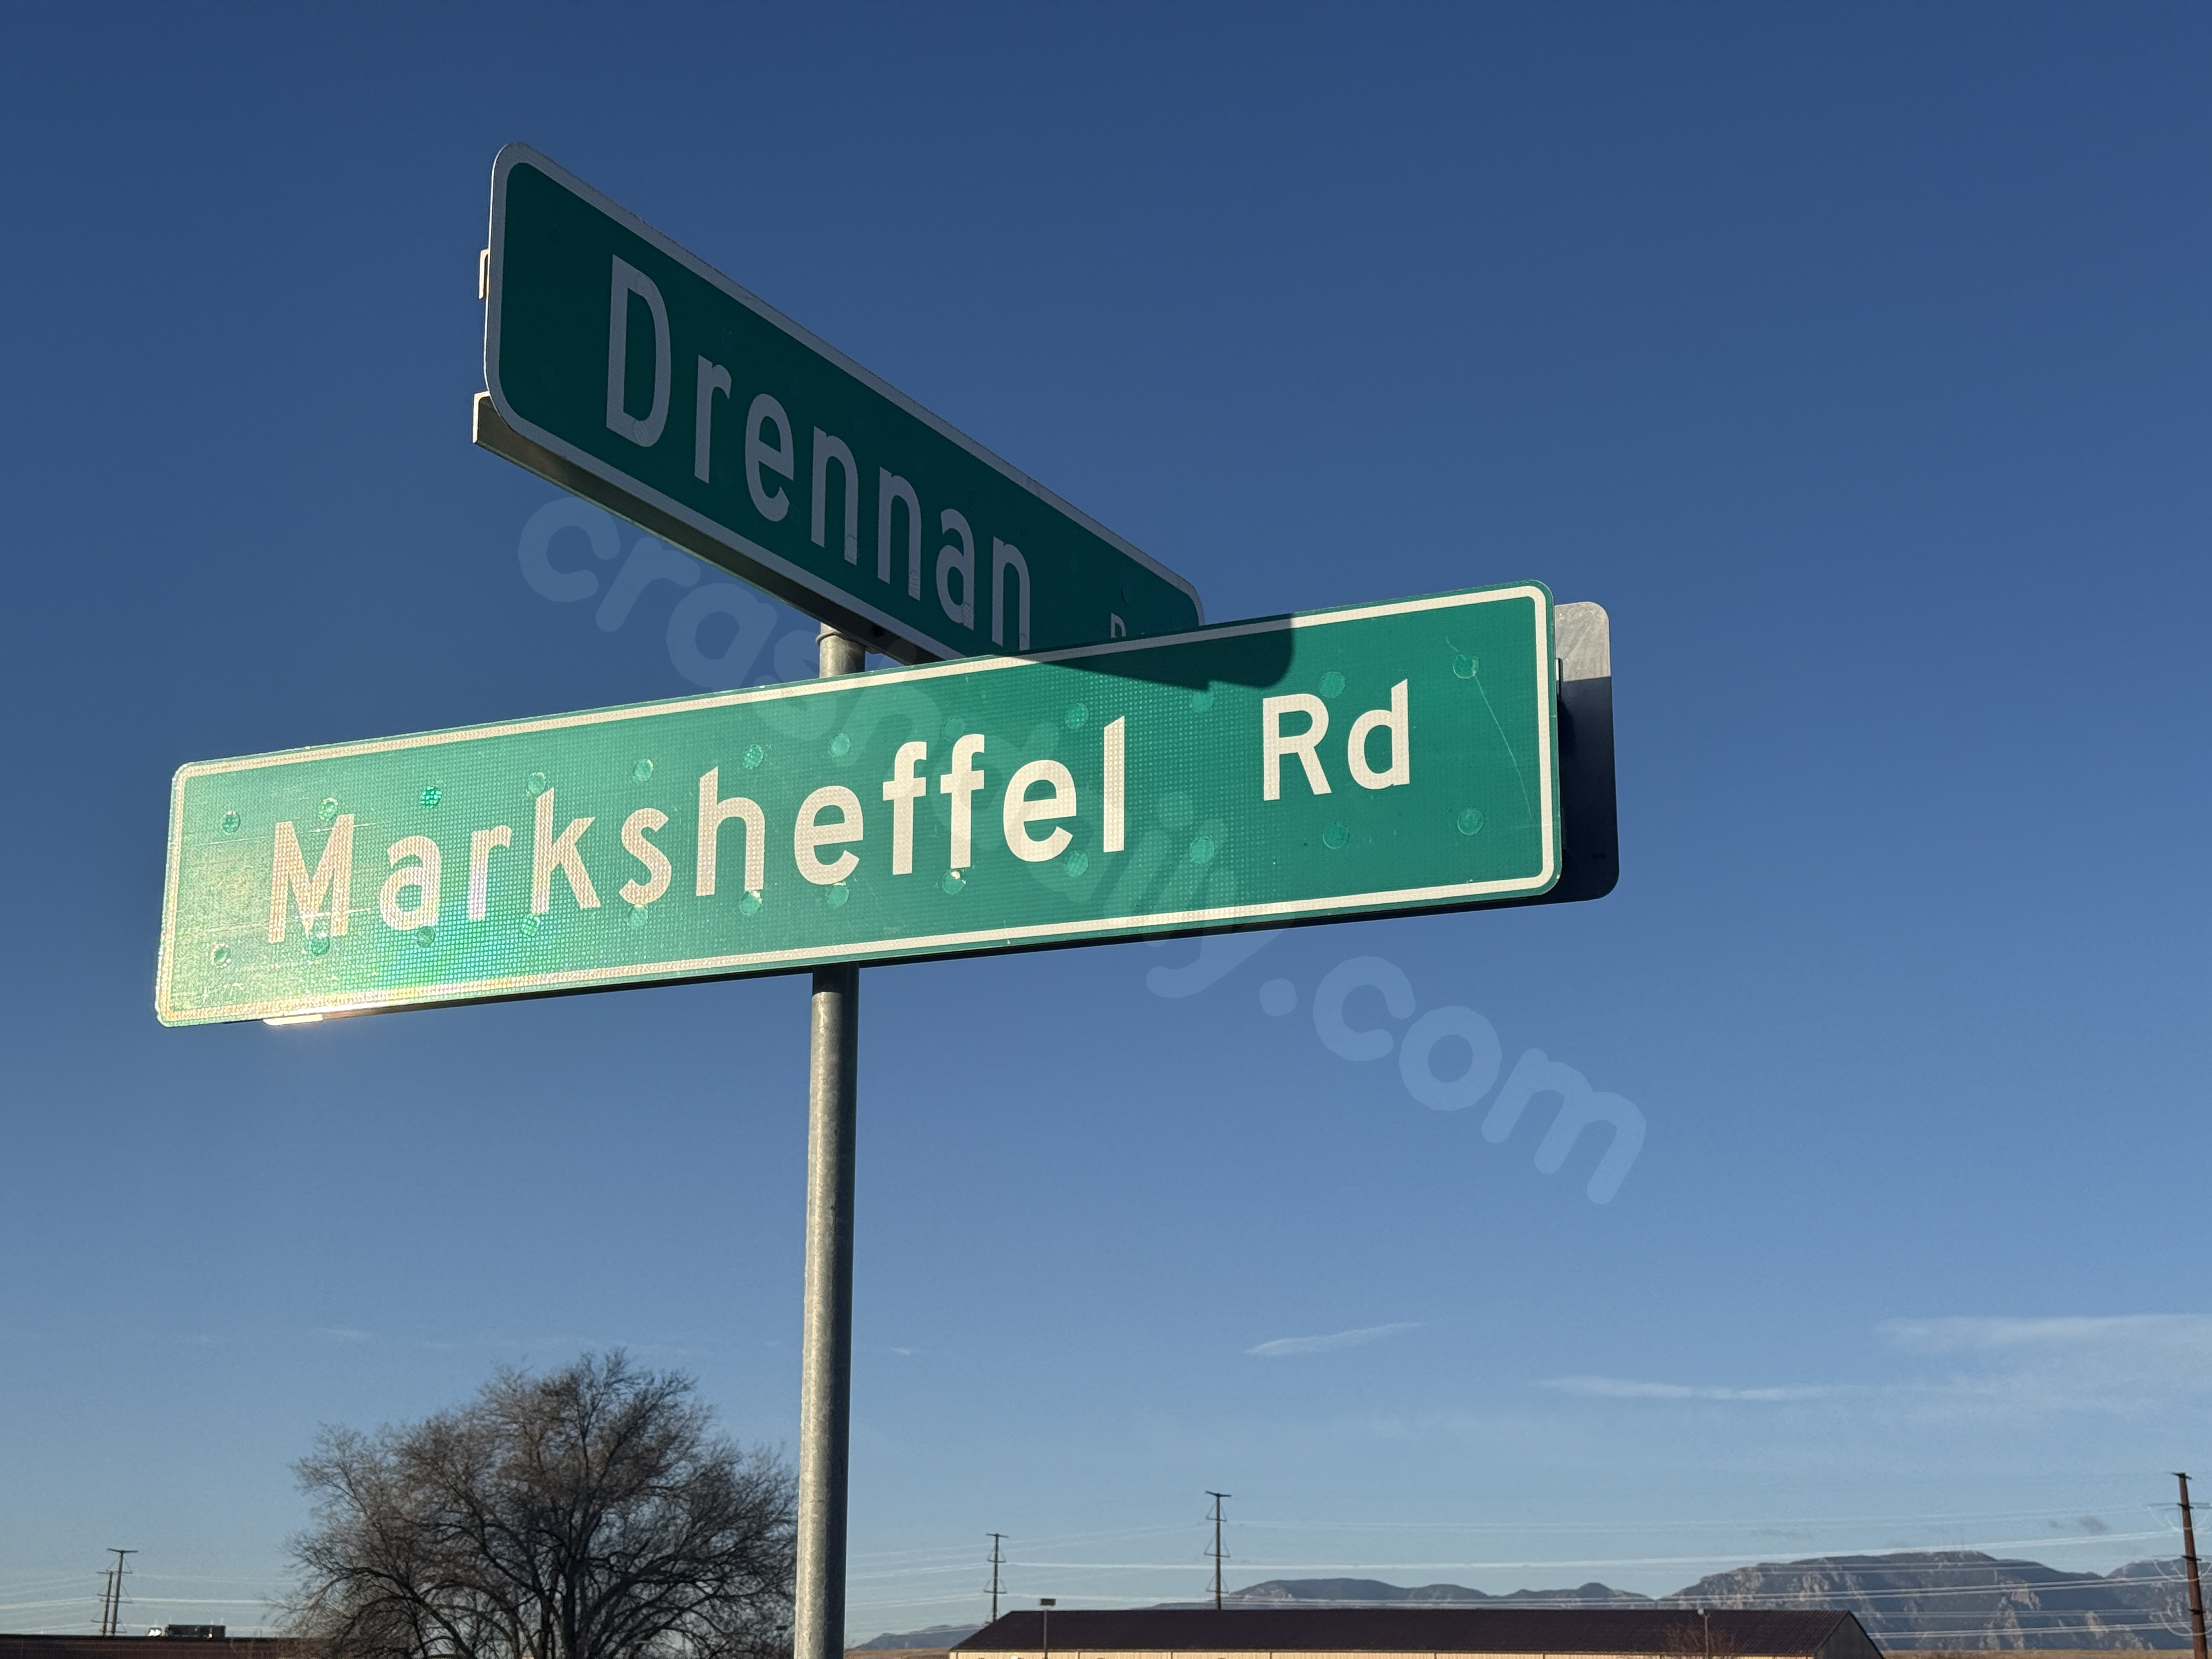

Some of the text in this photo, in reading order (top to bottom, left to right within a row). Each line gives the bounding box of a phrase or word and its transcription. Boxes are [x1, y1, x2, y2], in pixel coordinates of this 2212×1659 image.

[606, 254, 1031, 651] Drennan
[267, 678, 1410, 943] Marksheffel Rd
